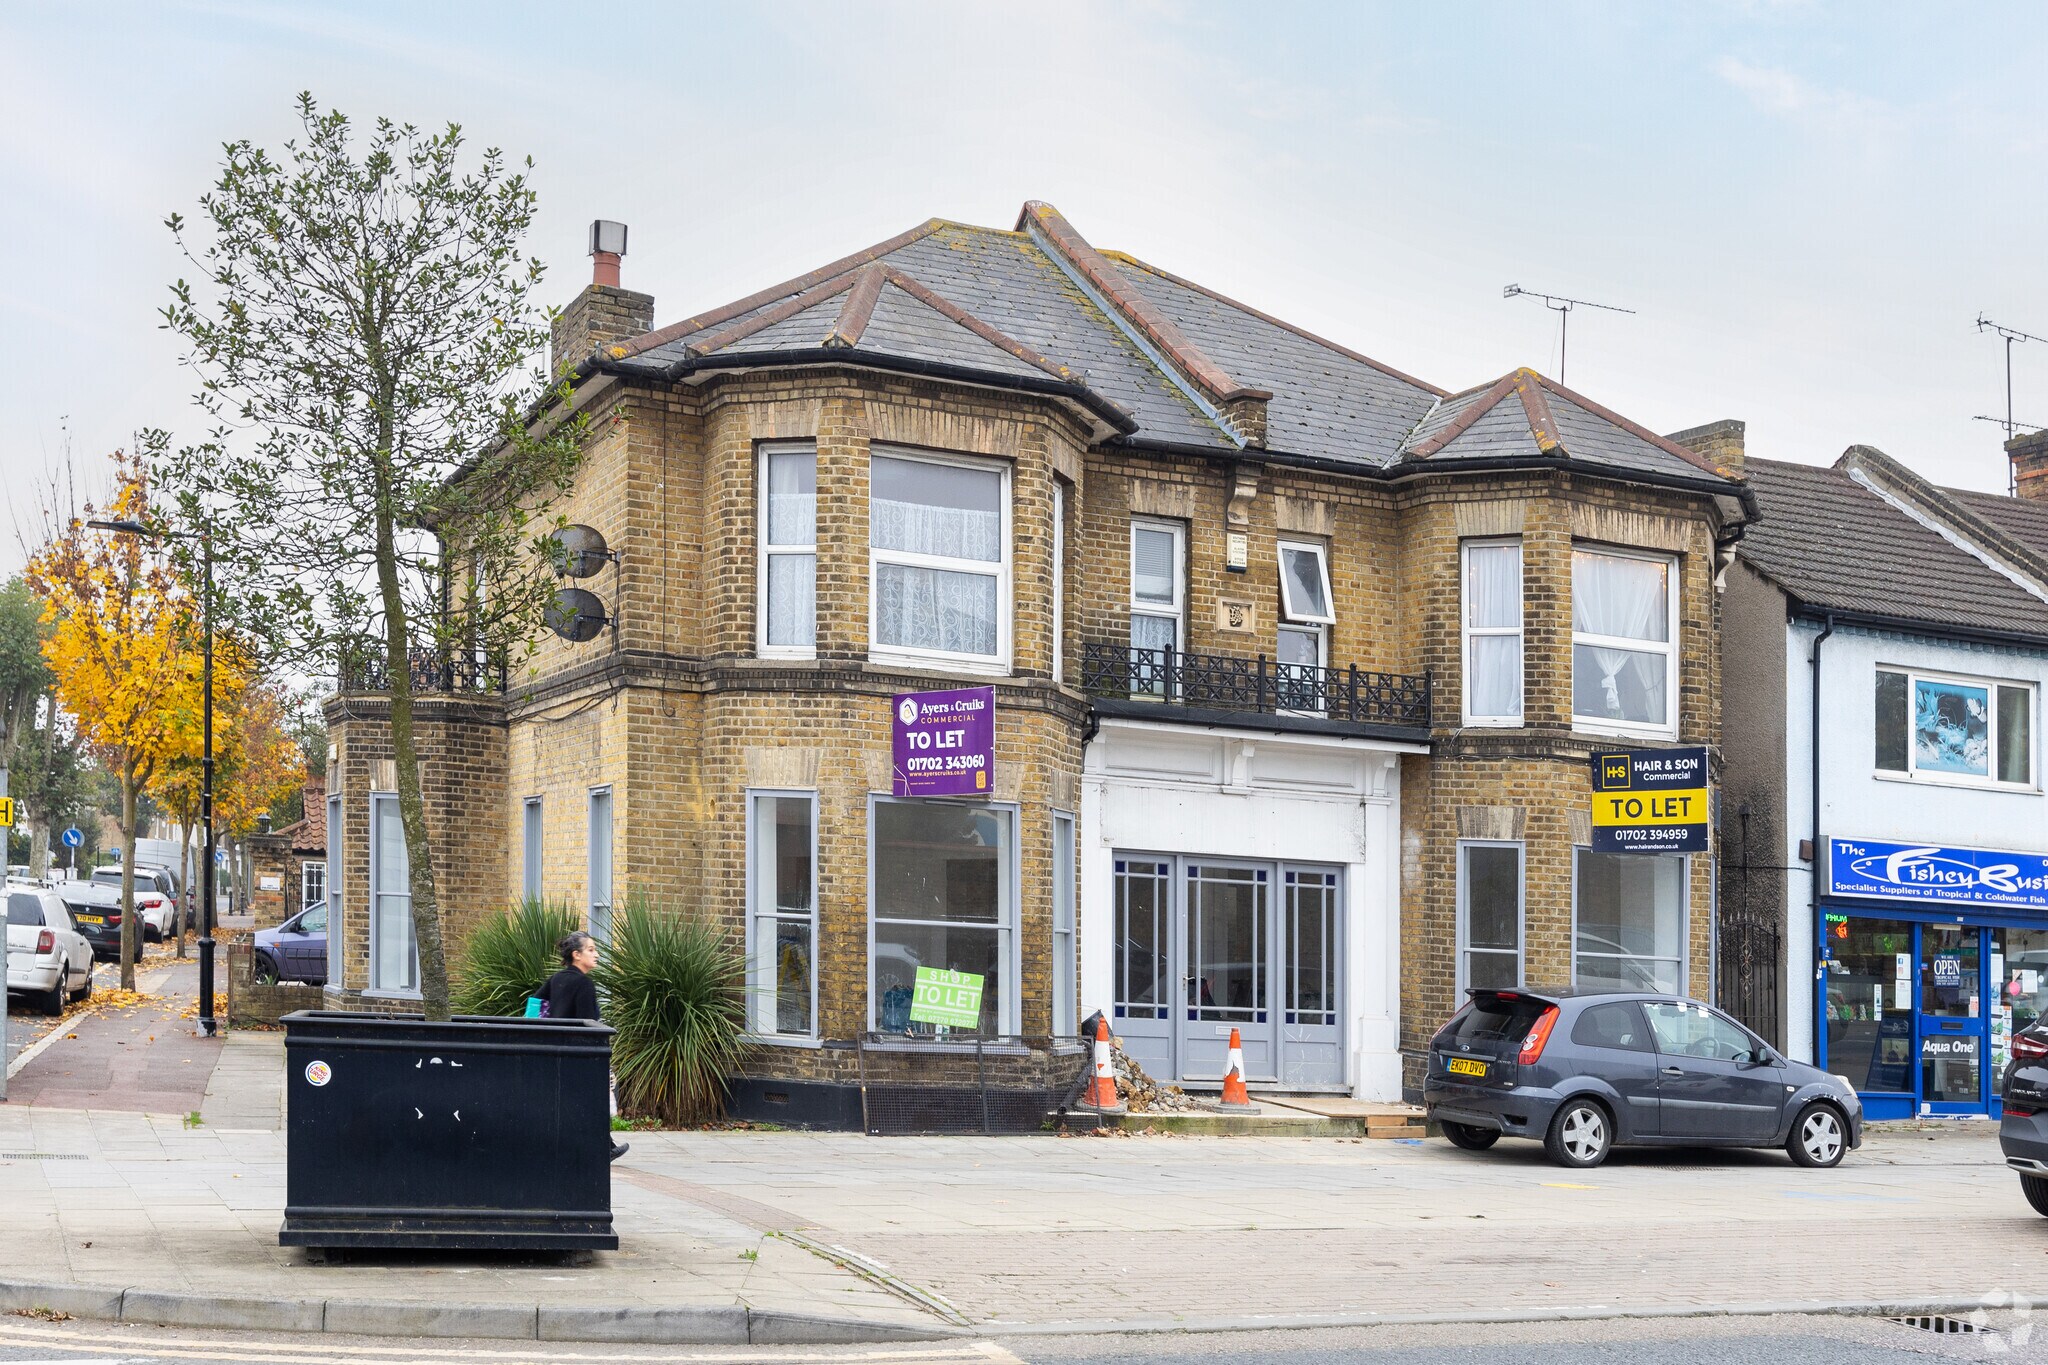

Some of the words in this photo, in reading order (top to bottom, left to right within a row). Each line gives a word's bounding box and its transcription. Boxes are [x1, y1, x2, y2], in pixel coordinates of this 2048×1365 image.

[921, 703, 949, 716] Ayers
[955, 699, 984, 711] Cruiks
[921, 714, 975, 724] COMMERCIAL
[907, 732, 931, 749] TO
[935, 730, 965, 748] LET
[907, 757, 943, 770] 01702
[945, 754, 985, 769] 343060
[1634, 761, 1662, 771] HAIR
[1665, 761, 1672, 770] &
[1675, 759, 1698, 769] SON
[1643, 771, 1690, 781] Commercial
[1610, 798, 1643, 818] TO
[1651, 797, 1691, 818] LET
[1615, 830, 1647, 840] 01702
[1650, 829, 1688, 840] 394959
[1835, 843, 1865, 856] The
[1886, 847, 1973, 889] Fishey
[1835, 882, 1877, 893] Specialist
[1880, 885, 1922, 898] Suppliers
[1936, 889, 1971, 899] Tropical
[1985, 893, 2027, 902] Coldwater
[1934, 960, 1960, 975] OPEN
[930, 971, 971, 984] SHOP
[917, 985, 940, 1004] TO
[945, 989, 979, 1009] LET
[1922, 1040, 1950, 1055] Aqua
[1952, 1041, 1974, 1053] One
[1451, 1060, 1469, 1071] EK07
[1469, 1062, 1485, 1074] DVO
